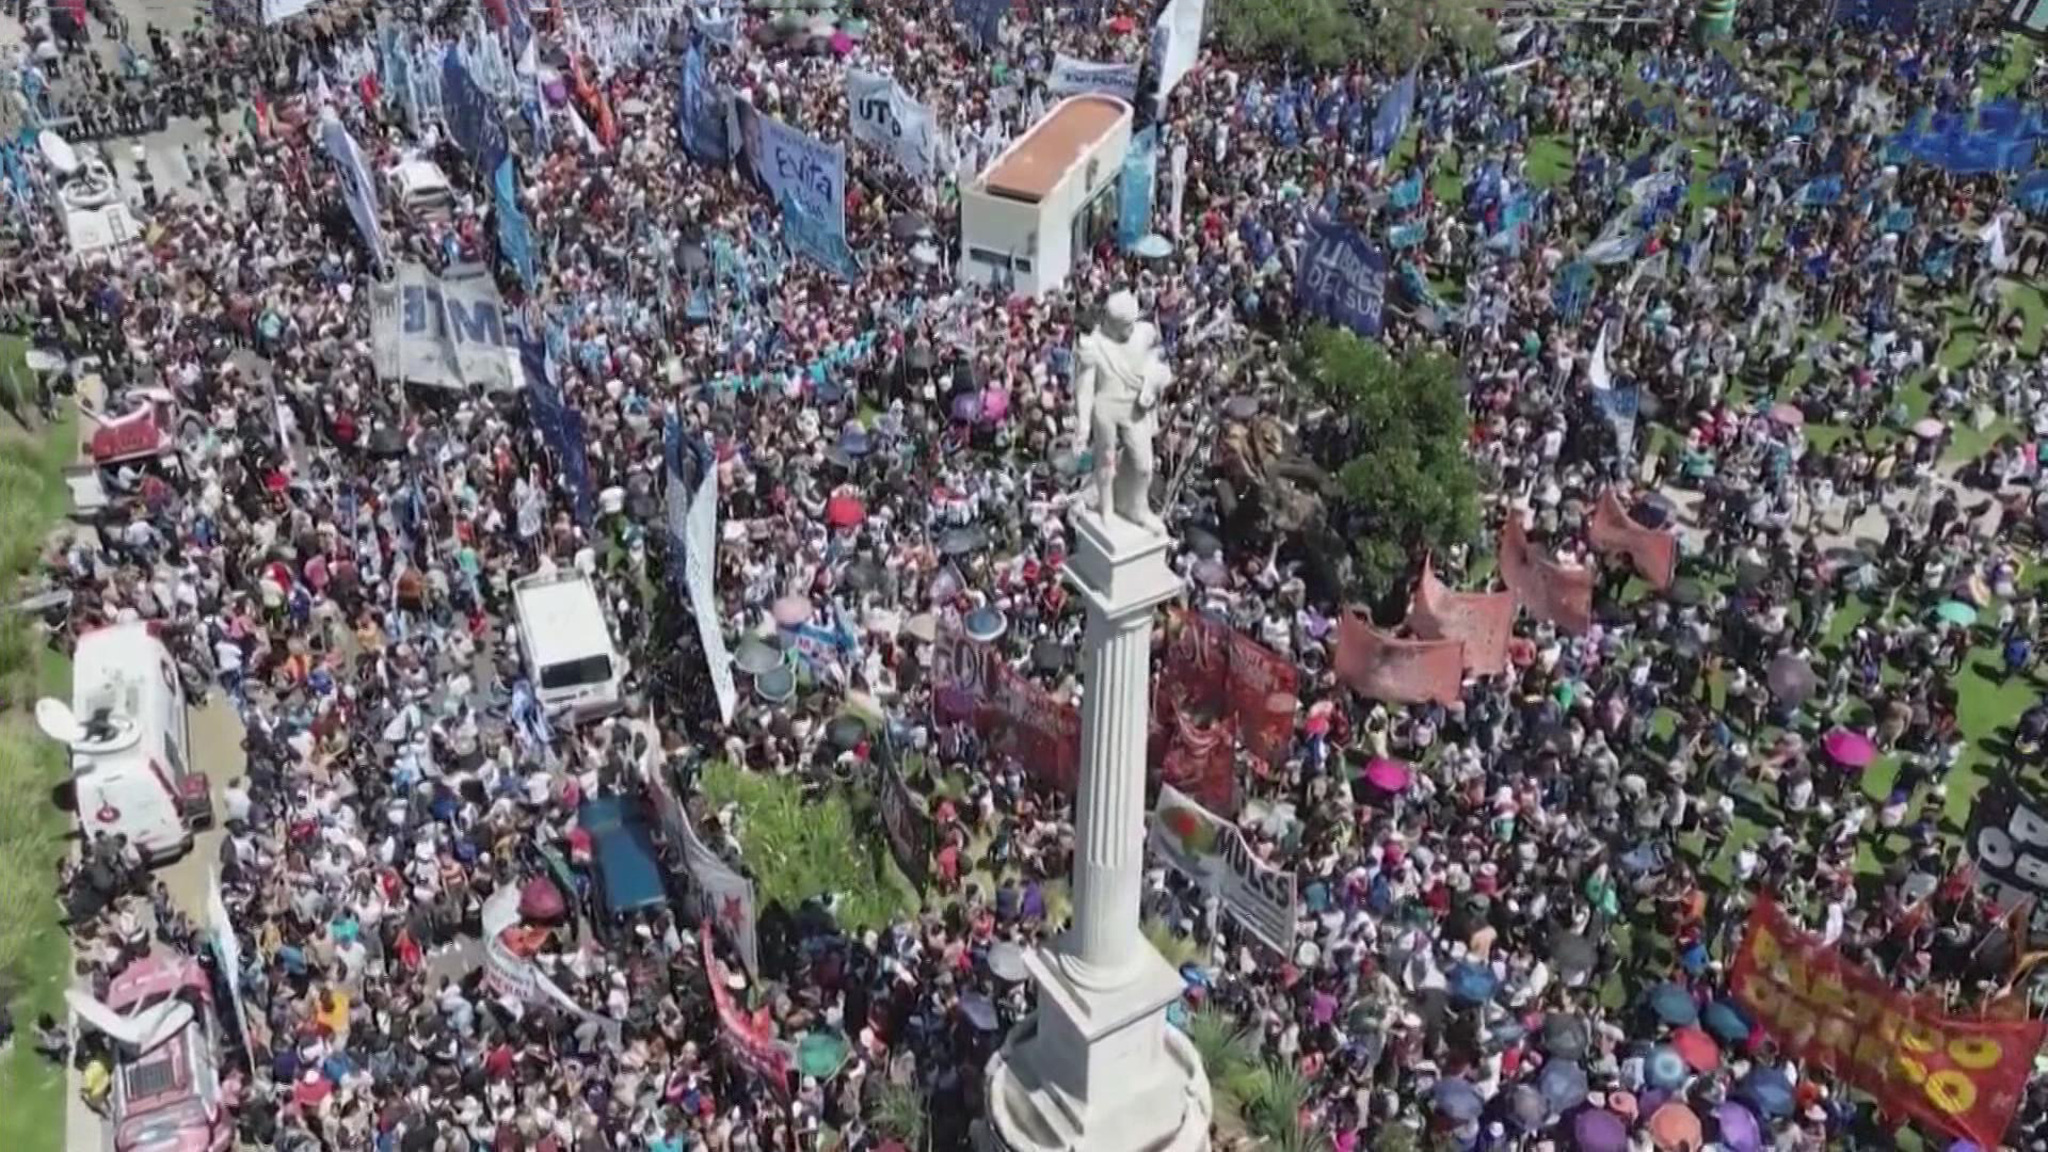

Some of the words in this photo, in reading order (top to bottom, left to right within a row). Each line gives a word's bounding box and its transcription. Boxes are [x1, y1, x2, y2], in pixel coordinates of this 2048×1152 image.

[1307, 262, 1342, 301] DEL
[1344, 287, 1383, 322] SUR
[1315, 238, 1385, 303] LIBRES
